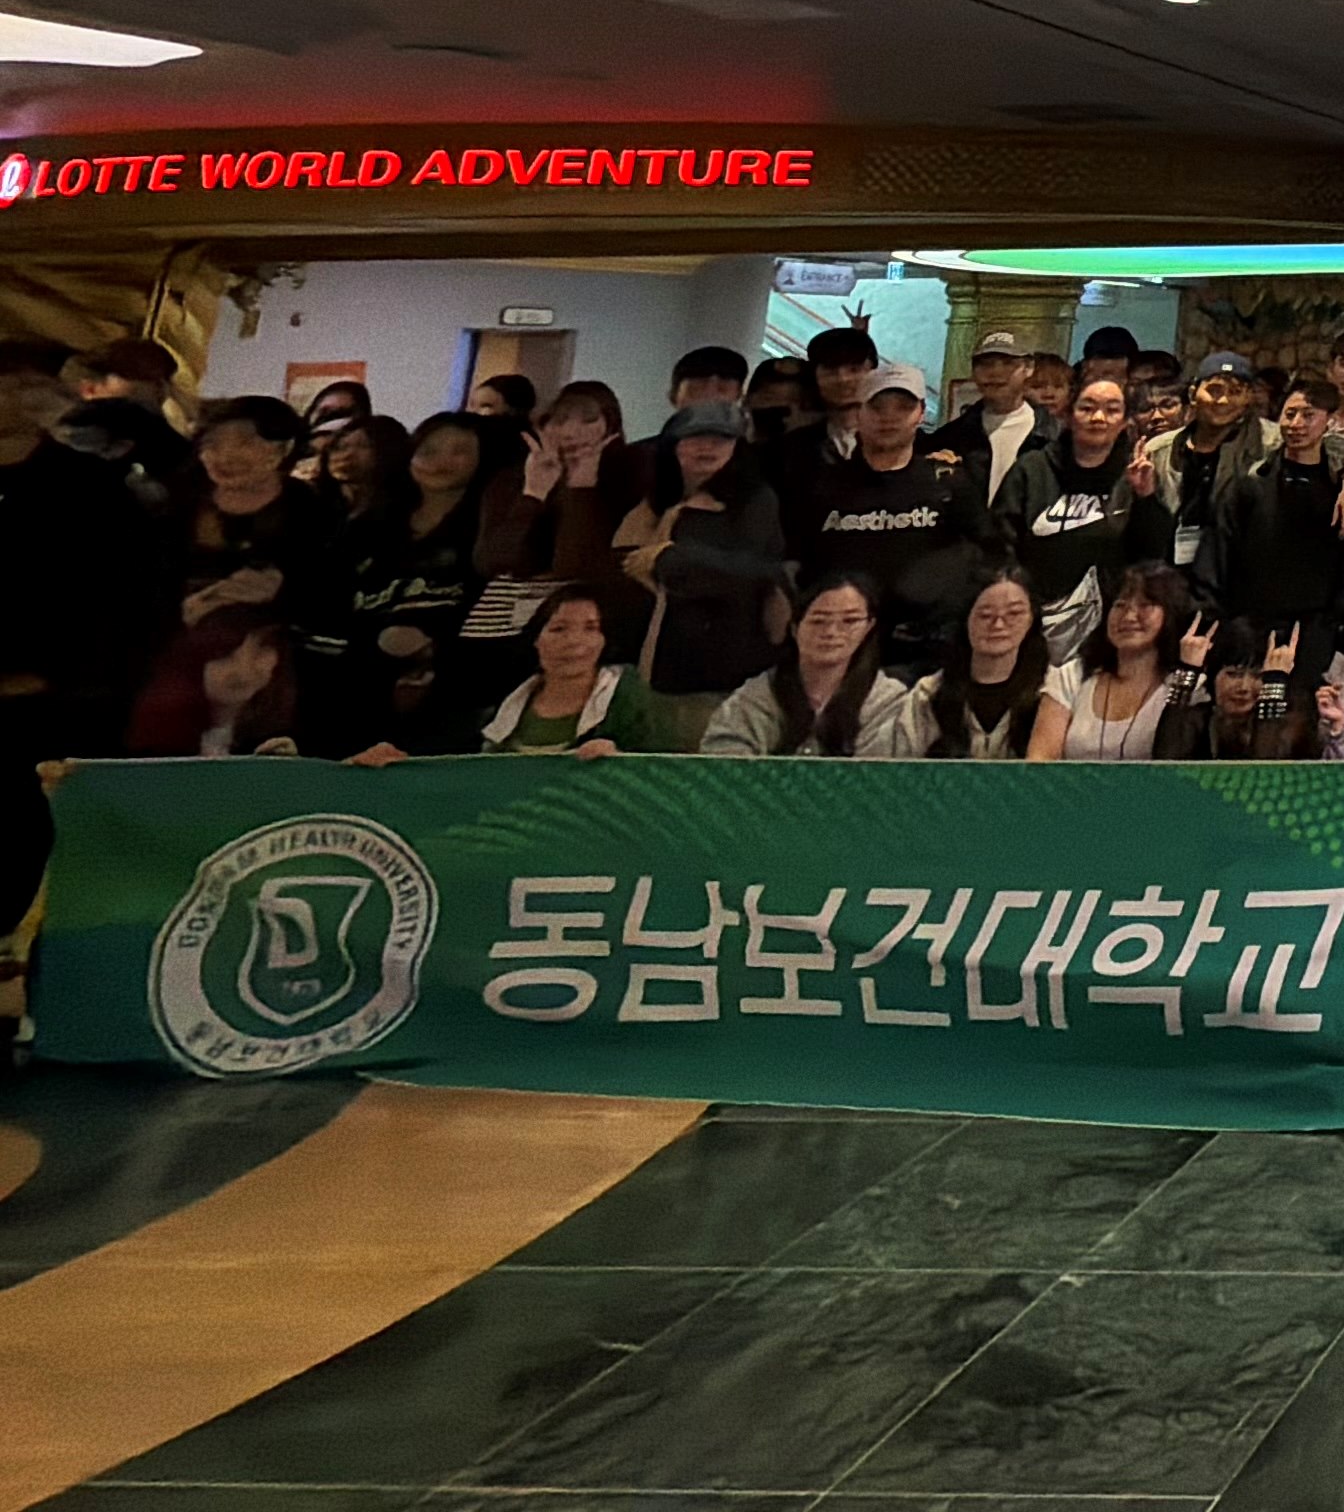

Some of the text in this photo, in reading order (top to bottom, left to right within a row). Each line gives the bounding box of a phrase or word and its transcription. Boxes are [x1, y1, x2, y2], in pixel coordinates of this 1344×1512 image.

[34, 154, 186, 198] LOTTE
[200, 150, 402, 189] WORLD
[410, 149, 814, 186] ADVENTURE
[822, 507, 939, 532] Aesthetic
